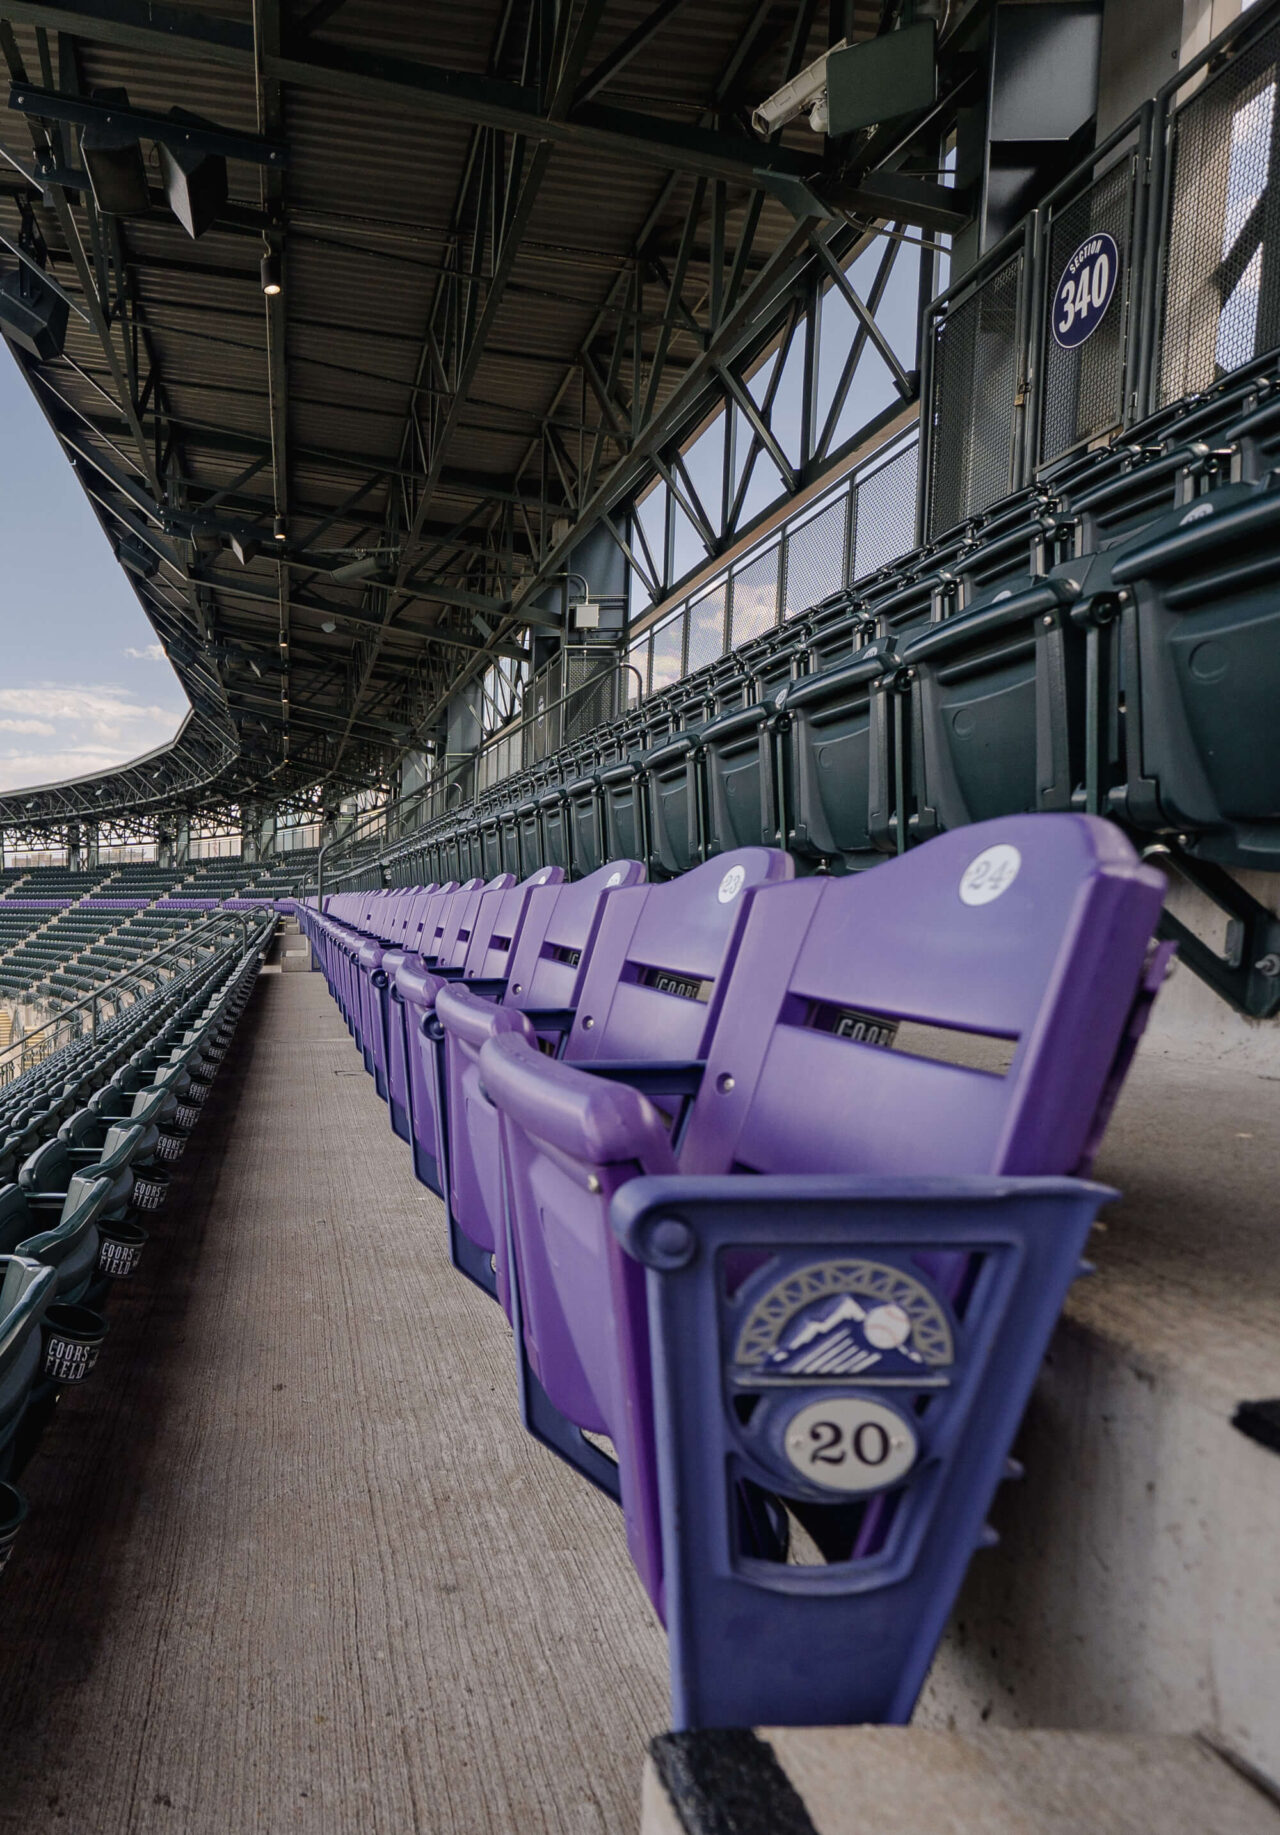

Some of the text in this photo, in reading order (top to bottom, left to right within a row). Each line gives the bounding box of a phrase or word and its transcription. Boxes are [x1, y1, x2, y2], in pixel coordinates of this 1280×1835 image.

[1070, 240, 1103, 274] SECTION
[1059, 253, 1109, 333] 340
[968, 860, 1010, 890] 24
[157, 1136, 181, 1150] COORS
[131, 1192, 159, 1209] FIELD
[134, 1181, 161, 1198] COORS
[101, 1242, 134, 1261] COORS
[99, 1255, 131, 1275] FIELD
[48, 1338, 90, 1362] COORS
[45, 1355, 86, 1380] FIELD
[810, 1421, 890, 1466] 20
